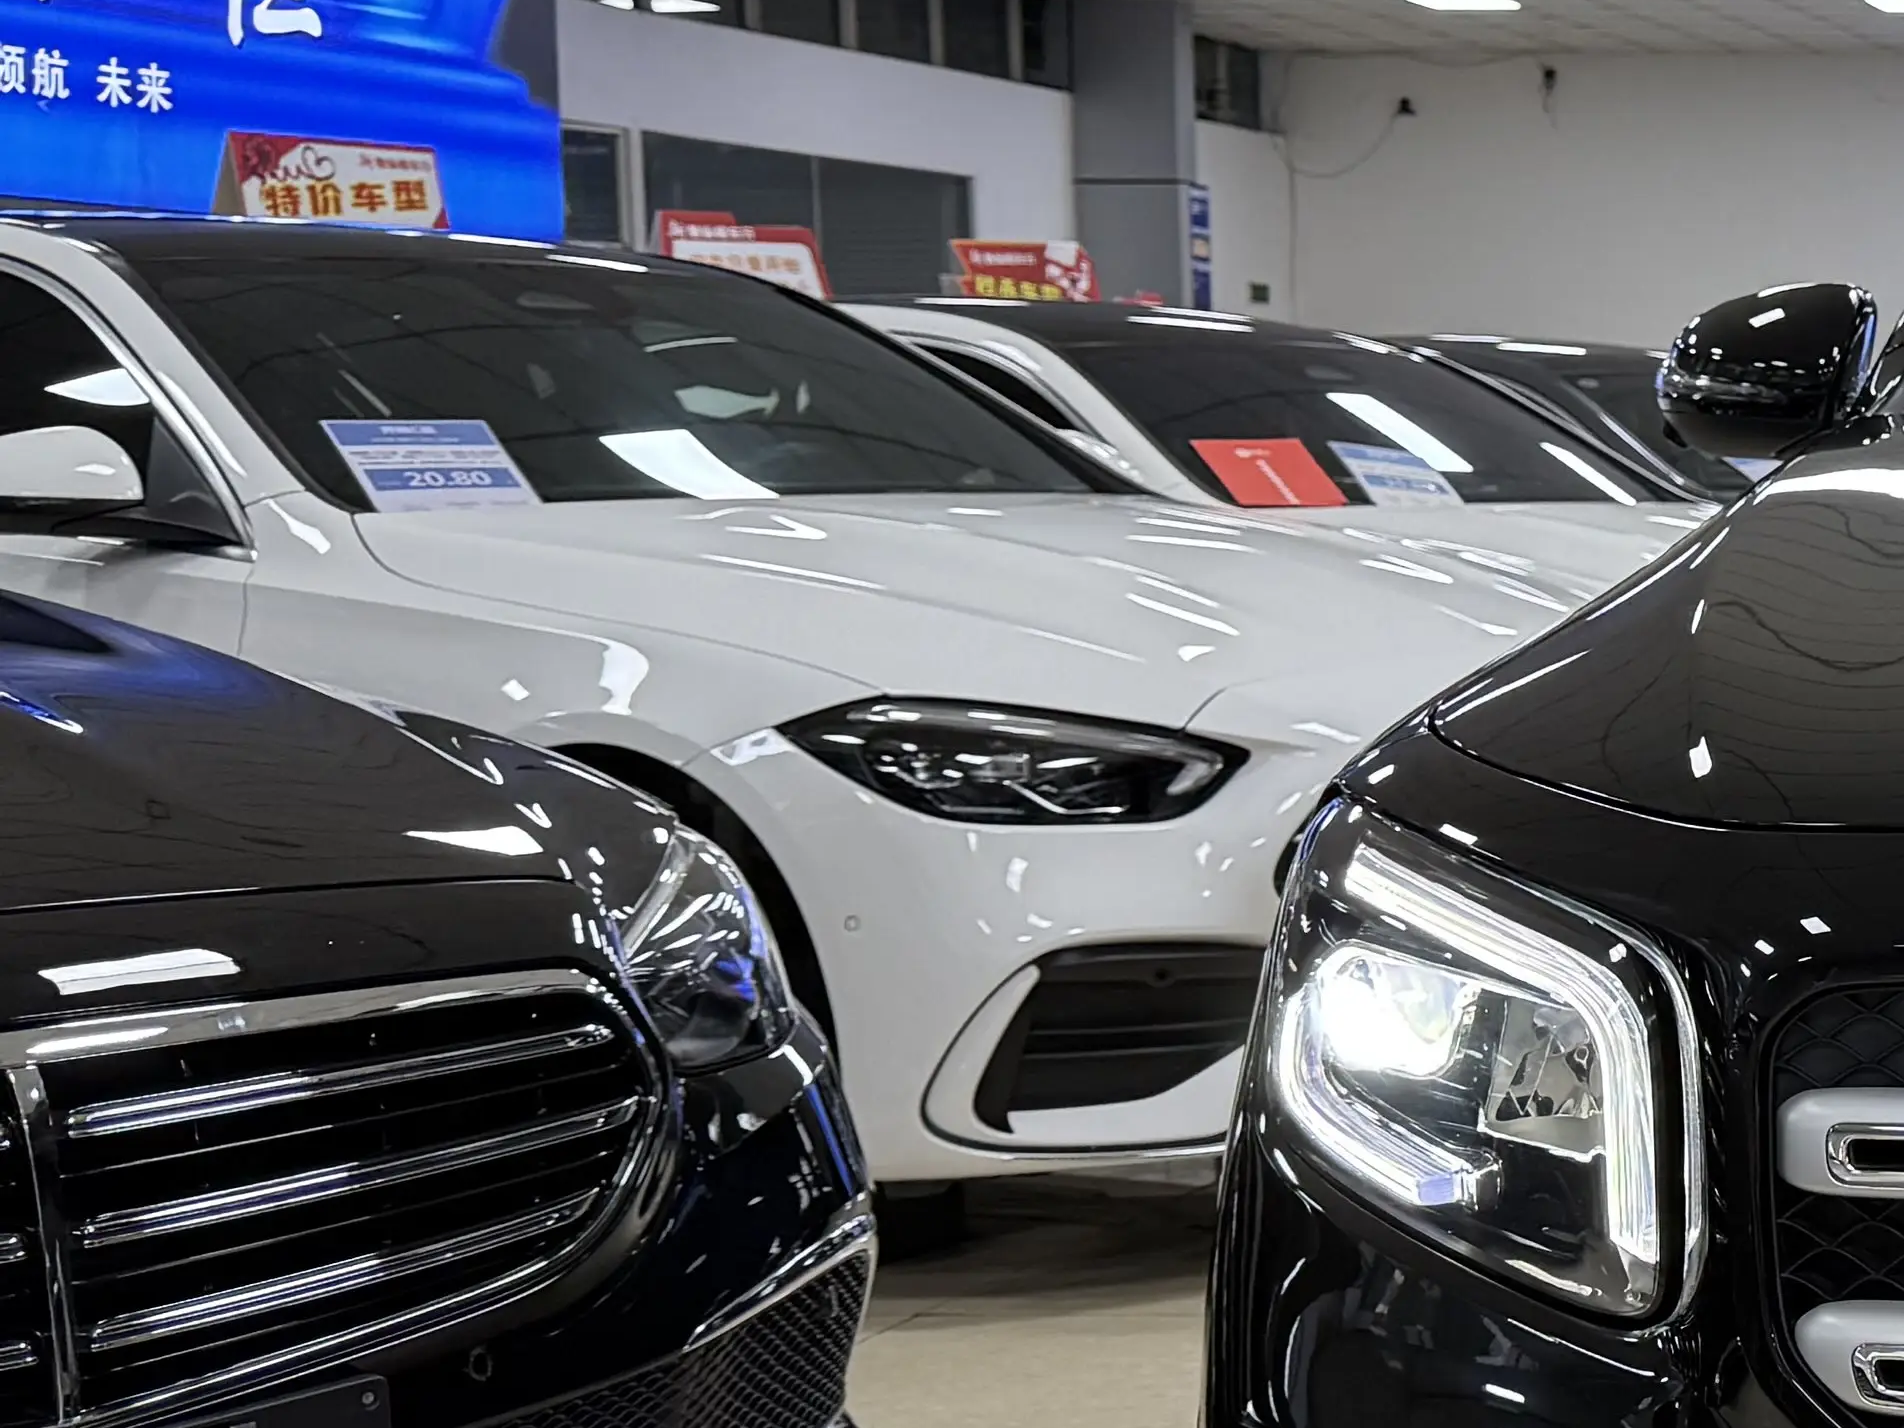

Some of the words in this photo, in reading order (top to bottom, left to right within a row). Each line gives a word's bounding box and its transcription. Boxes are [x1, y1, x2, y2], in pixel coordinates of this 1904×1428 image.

[96, 57, 173, 113] 未来
[259, 180, 429, 217] 特价车型
[402, 471, 493, 487] 20.80
